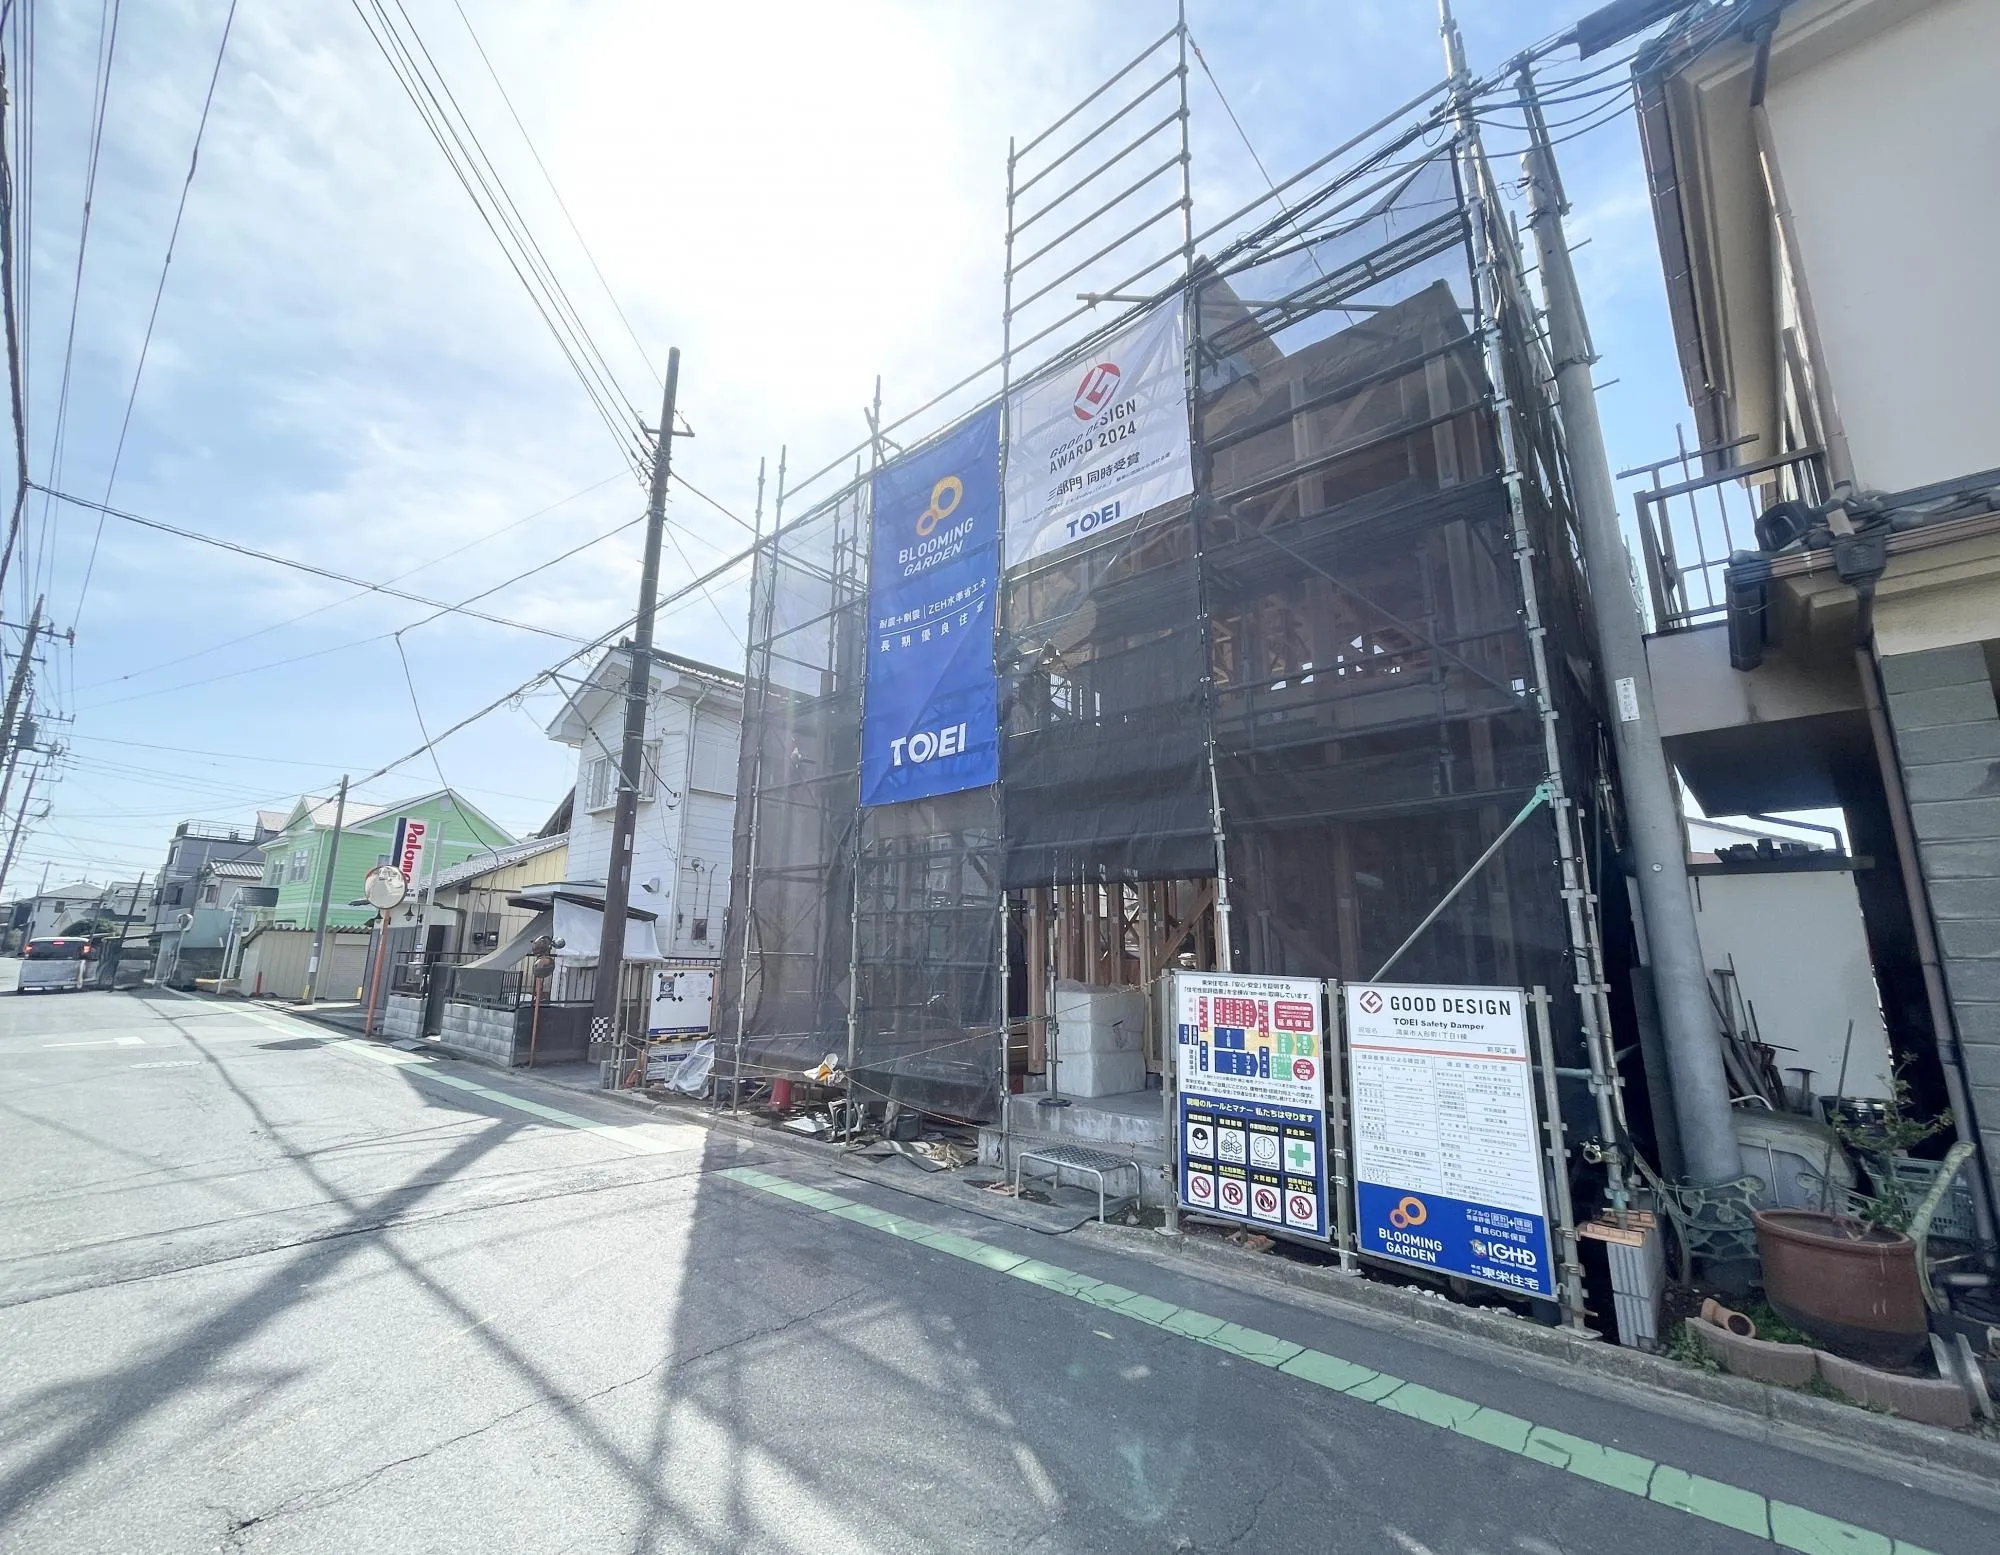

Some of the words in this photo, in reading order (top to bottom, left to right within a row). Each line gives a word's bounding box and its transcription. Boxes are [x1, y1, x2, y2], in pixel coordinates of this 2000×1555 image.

[1049, 433, 1083, 460] GOOD
[1085, 399, 1137, 437] DESIGN
[1049, 440, 1093, 474] AWARD
[1098, 420, 1137, 448] 2024
[1047, 475, 1083, 502] 三部門
[1086, 451, 1141, 486] 同時受賞
[898, 516, 974, 565] BLOOMING
[903, 541, 964, 577] GARDEN
[1390, 996, 1436, 1012] GOOD
[1442, 998, 1512, 1016] DESIGN
[1421, 1020, 1448, 1029] Safety
[1450, 1022, 1485, 1031] Damper
[1255, 1107, 1315, 1123] 私たちは守ります
[1286, 1128, 1312, 1137] 安全第一
[1466, 1208, 1490, 1218] ダブルの
[1378, 1227, 1443, 1252] BLOOMING
[1474, 1225, 1527, 1243] 最長60年保証
[1386, 1242, 1436, 1263] GARDEN
[1482, 1266, 1540, 1291] 東栄住宅
